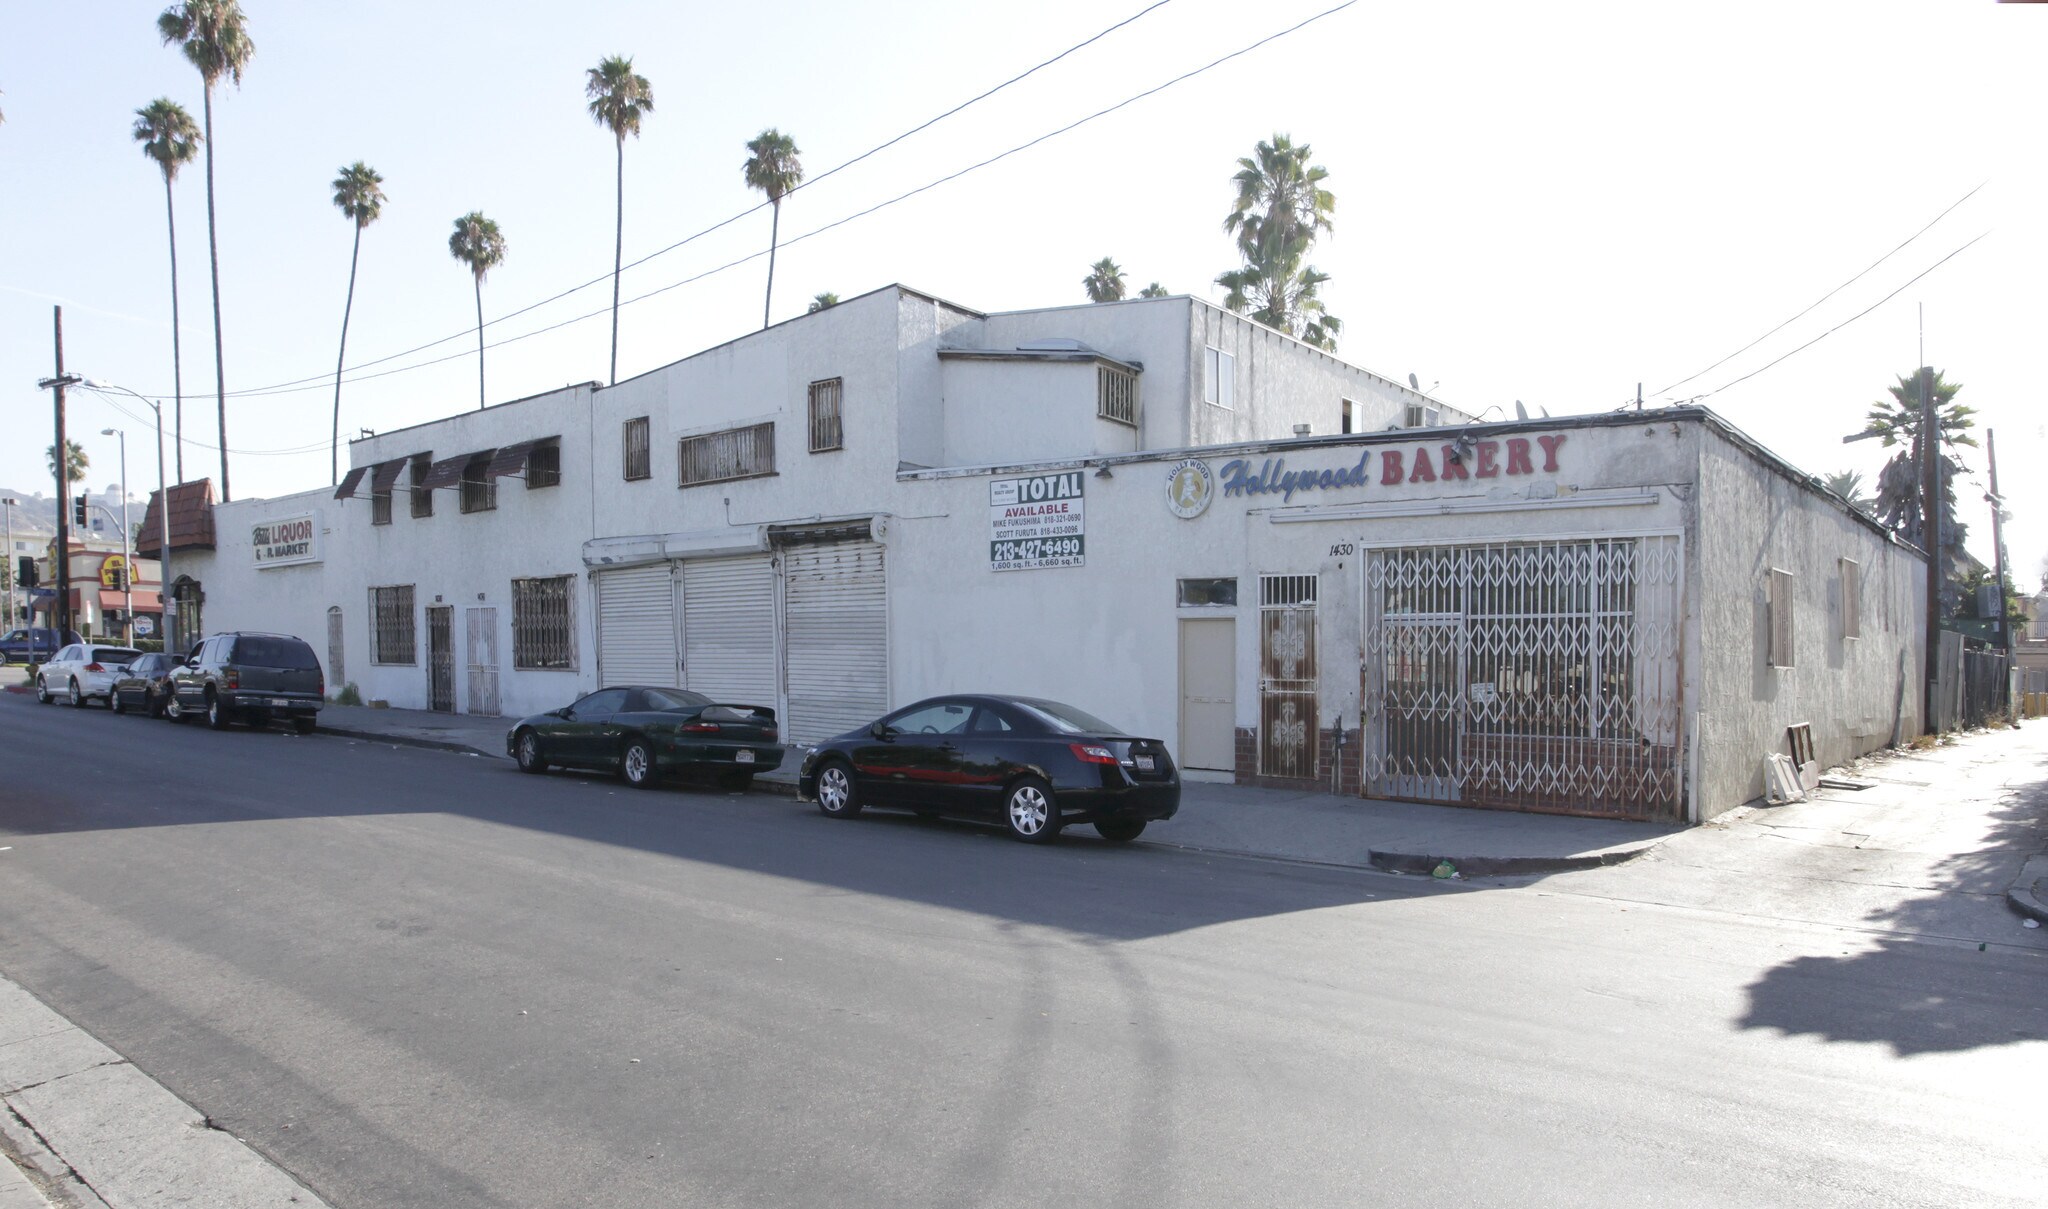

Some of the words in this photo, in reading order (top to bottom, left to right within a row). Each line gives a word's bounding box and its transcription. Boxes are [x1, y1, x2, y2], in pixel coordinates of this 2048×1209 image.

[1168, 460, 1209, 481] HOLLYWOOD
[1219, 450, 1371, 503] Hollywood
[1379, 434, 1567, 485] BAKERY
[1019, 473, 1081, 502] TOTAL
[1005, 503, 1069, 518] AVAILABLE
[1007, 516, 1041, 527] FUKUSHIMA
[272, 520, 313, 545] LIQUOR
[996, 530, 1013, 538] SCOTT
[275, 542, 309, 557] MARKET
[994, 538, 1080, 561] 213-427-6490
[1329, 543, 1354, 557] 1430
[992, 561, 1011, 570] 1,600
[1038, 558, 1059, 567] 6,660
[1073, 556, 1081, 564] ft.
